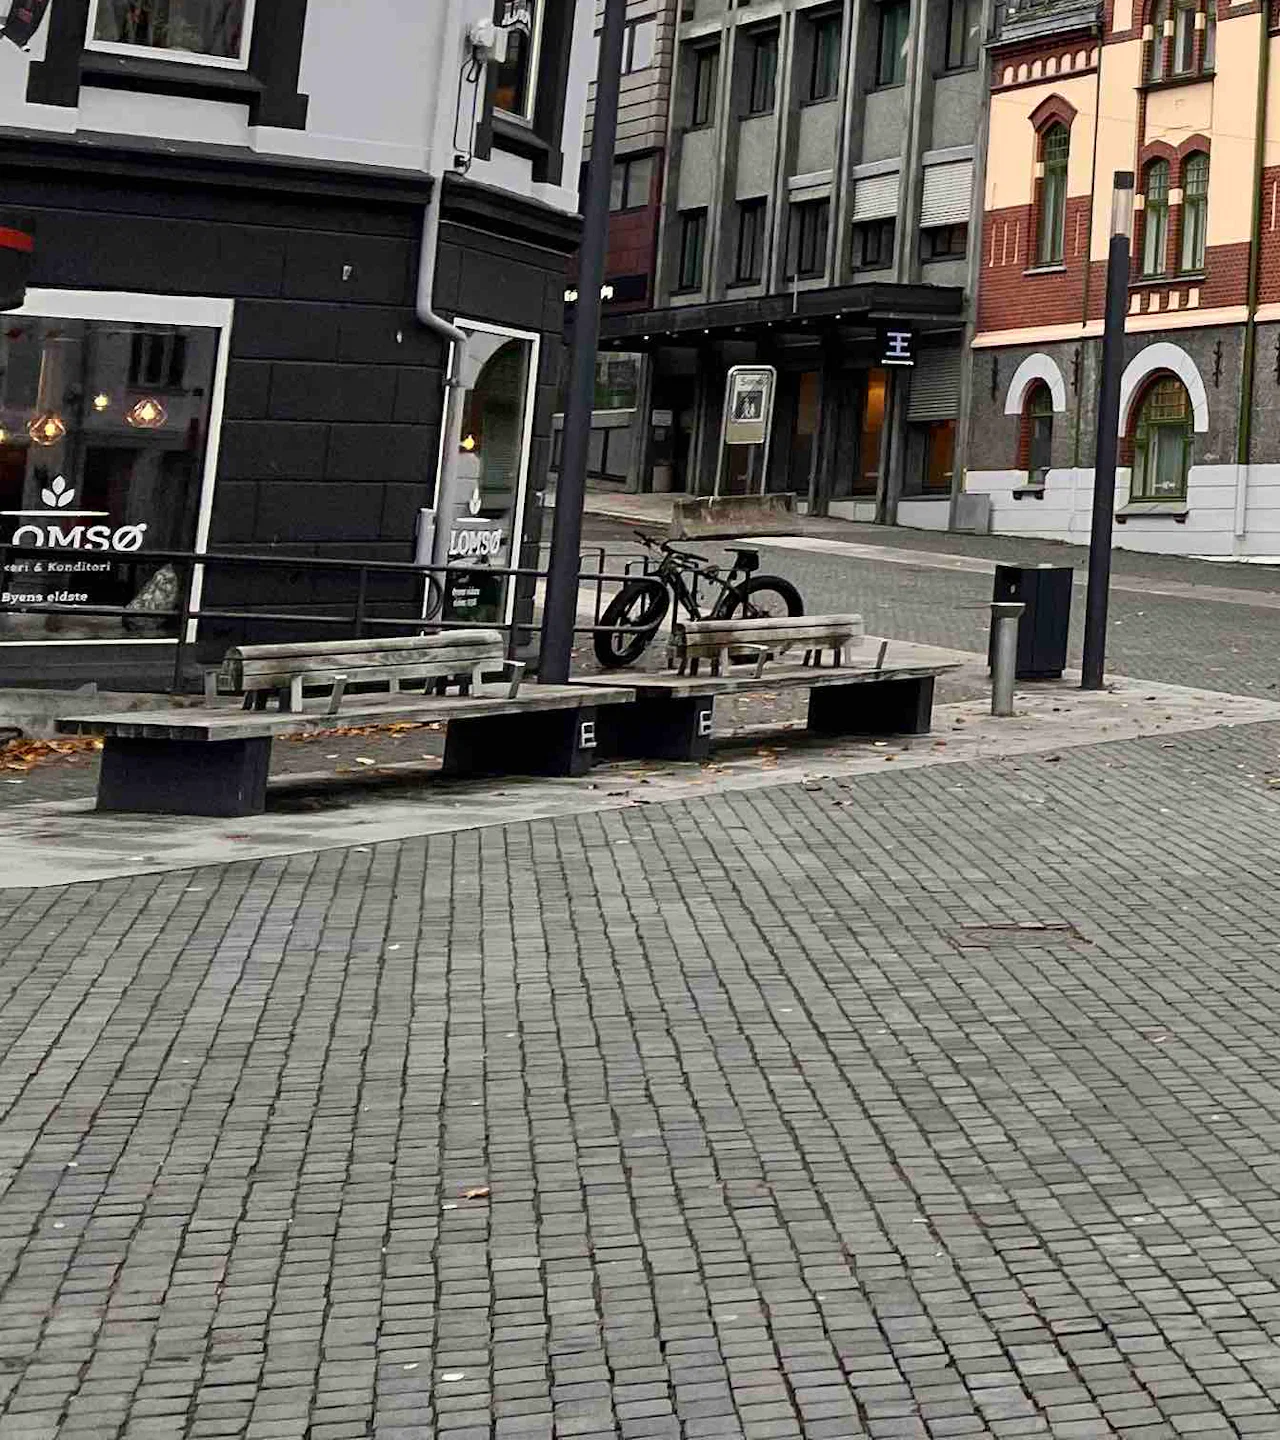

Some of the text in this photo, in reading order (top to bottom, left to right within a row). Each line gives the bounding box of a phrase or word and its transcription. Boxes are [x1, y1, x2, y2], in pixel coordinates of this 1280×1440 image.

[12, 523, 147, 552] OMSØ
[449, 528, 503, 556] LOMSØ
[47, 561, 111, 573] Konditori
